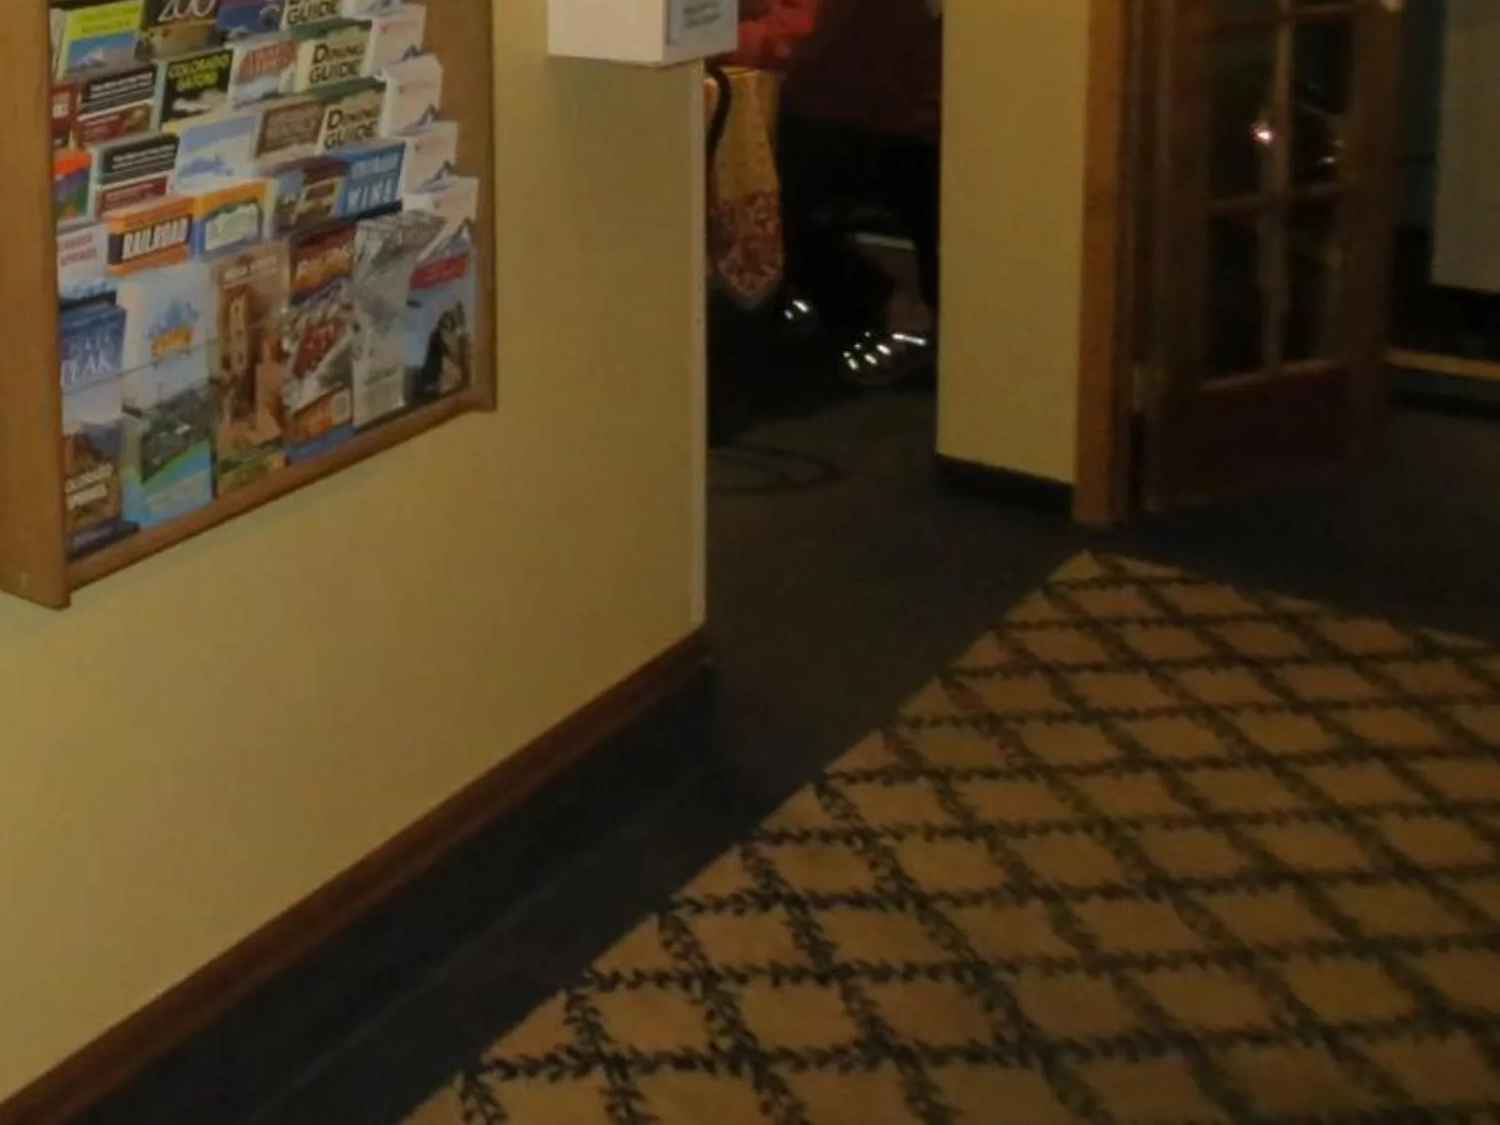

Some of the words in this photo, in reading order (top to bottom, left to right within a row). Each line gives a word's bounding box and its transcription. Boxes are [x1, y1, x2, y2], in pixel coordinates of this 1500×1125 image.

[309, 58, 364, 85] GUIDE
[323, 120, 378, 151] GUIDE
[122, 218, 189, 260] RAILROAD
